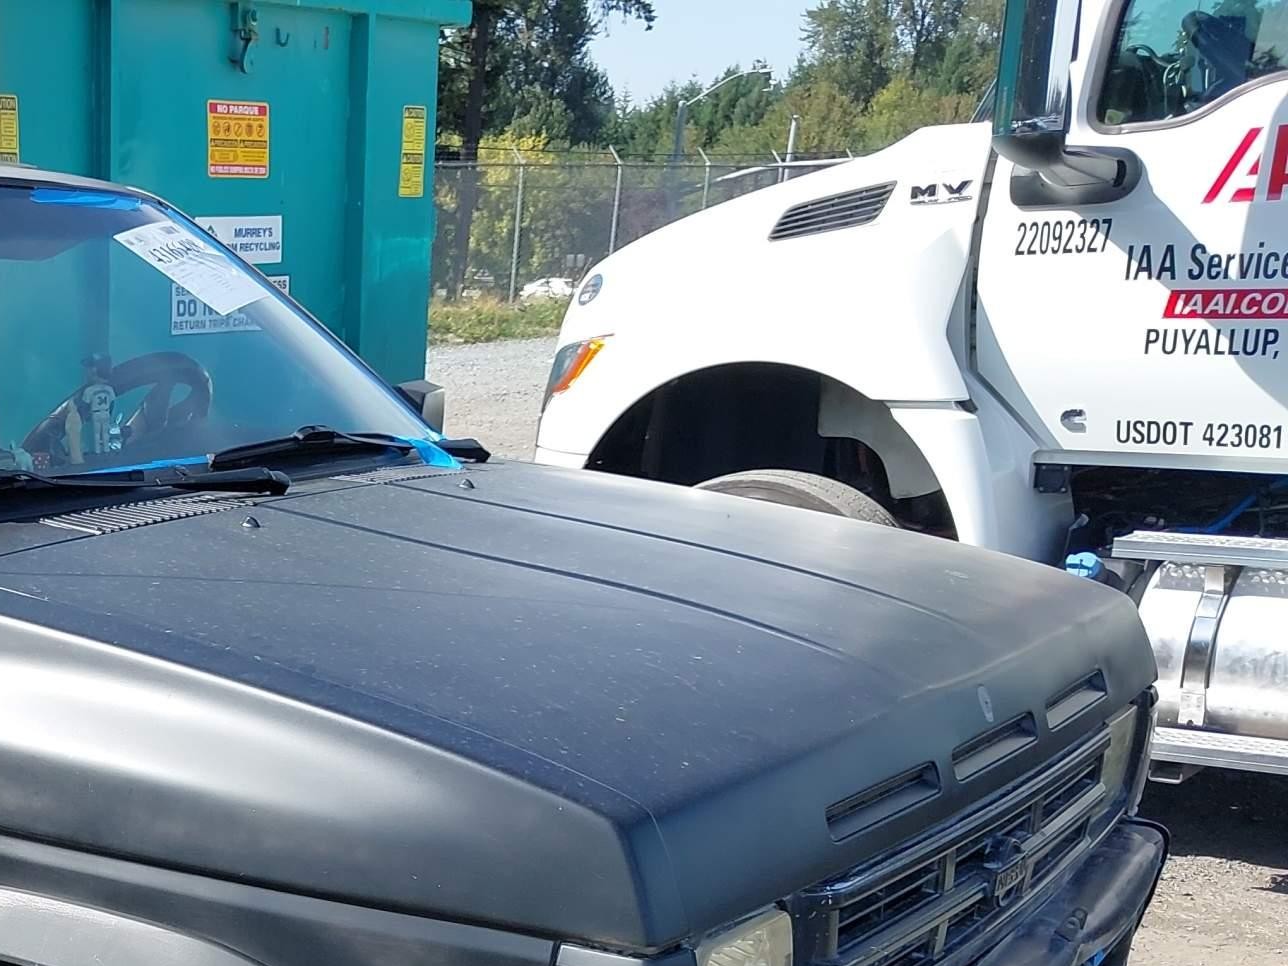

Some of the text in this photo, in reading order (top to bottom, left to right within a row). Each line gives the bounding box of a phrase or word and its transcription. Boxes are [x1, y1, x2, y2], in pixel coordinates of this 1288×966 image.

[216, 104, 259, 116] NO PARQUE
[234, 227, 273, 239] MURREY'S
[1015, 218, 1112, 256] 22092327
[239, 241, 280, 252] RECYCLING
[1124, 243, 1177, 281] IAA
[177, 299, 197, 317] DO
[1173, 291, 1288, 316] IAAI.CO
[173, 320, 206, 331] RETURN
[1144, 328, 1280, 360] PUYALLUP,
[1116, 420, 1194, 446] USDOT
[1202, 422, 1283, 449] 423081
